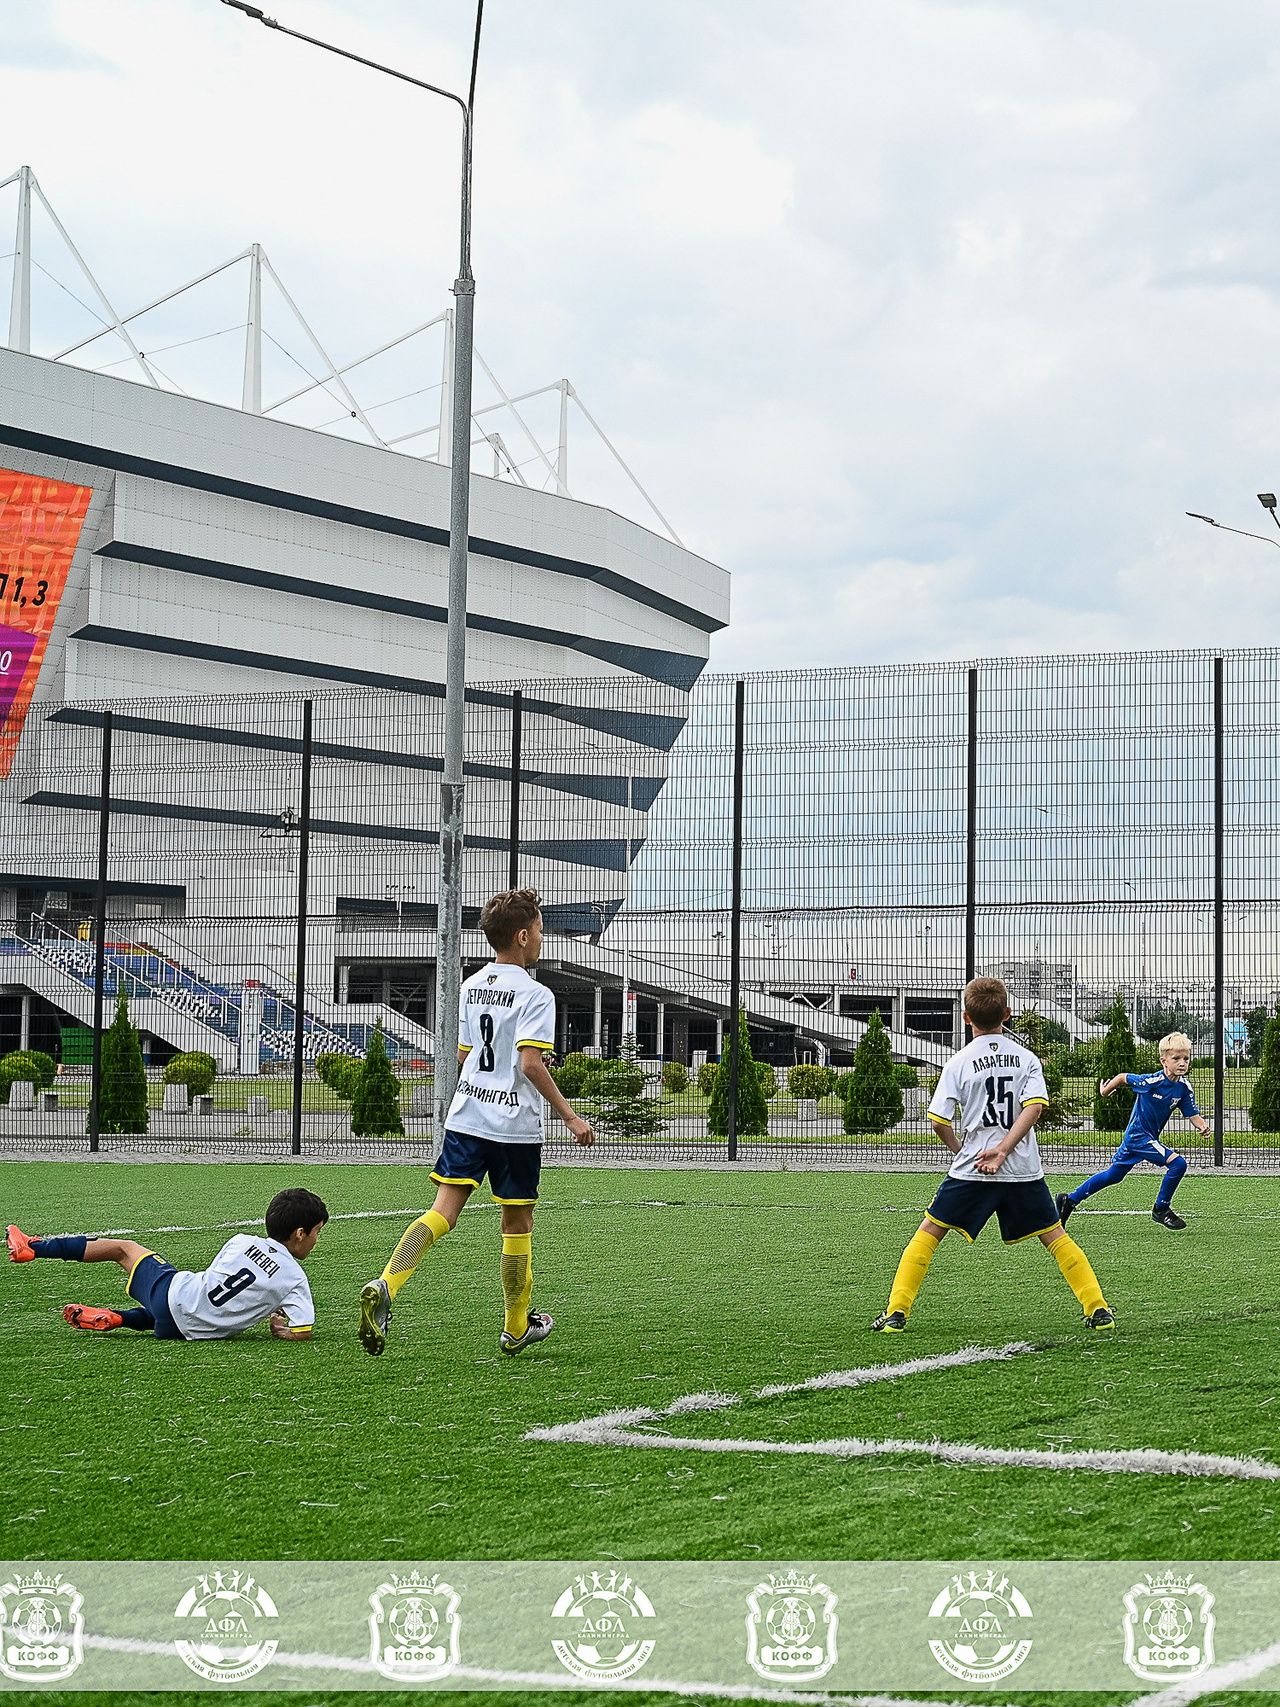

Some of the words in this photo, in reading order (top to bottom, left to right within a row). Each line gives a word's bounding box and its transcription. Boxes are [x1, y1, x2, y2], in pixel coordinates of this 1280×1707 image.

[478, 1013, 496, 1073] 8
[457, 1079, 519, 1107] КНИНГРАД
[244, 1244, 281, 1279] КИЕВЕЦ
[207, 1267, 257, 1308] 9
